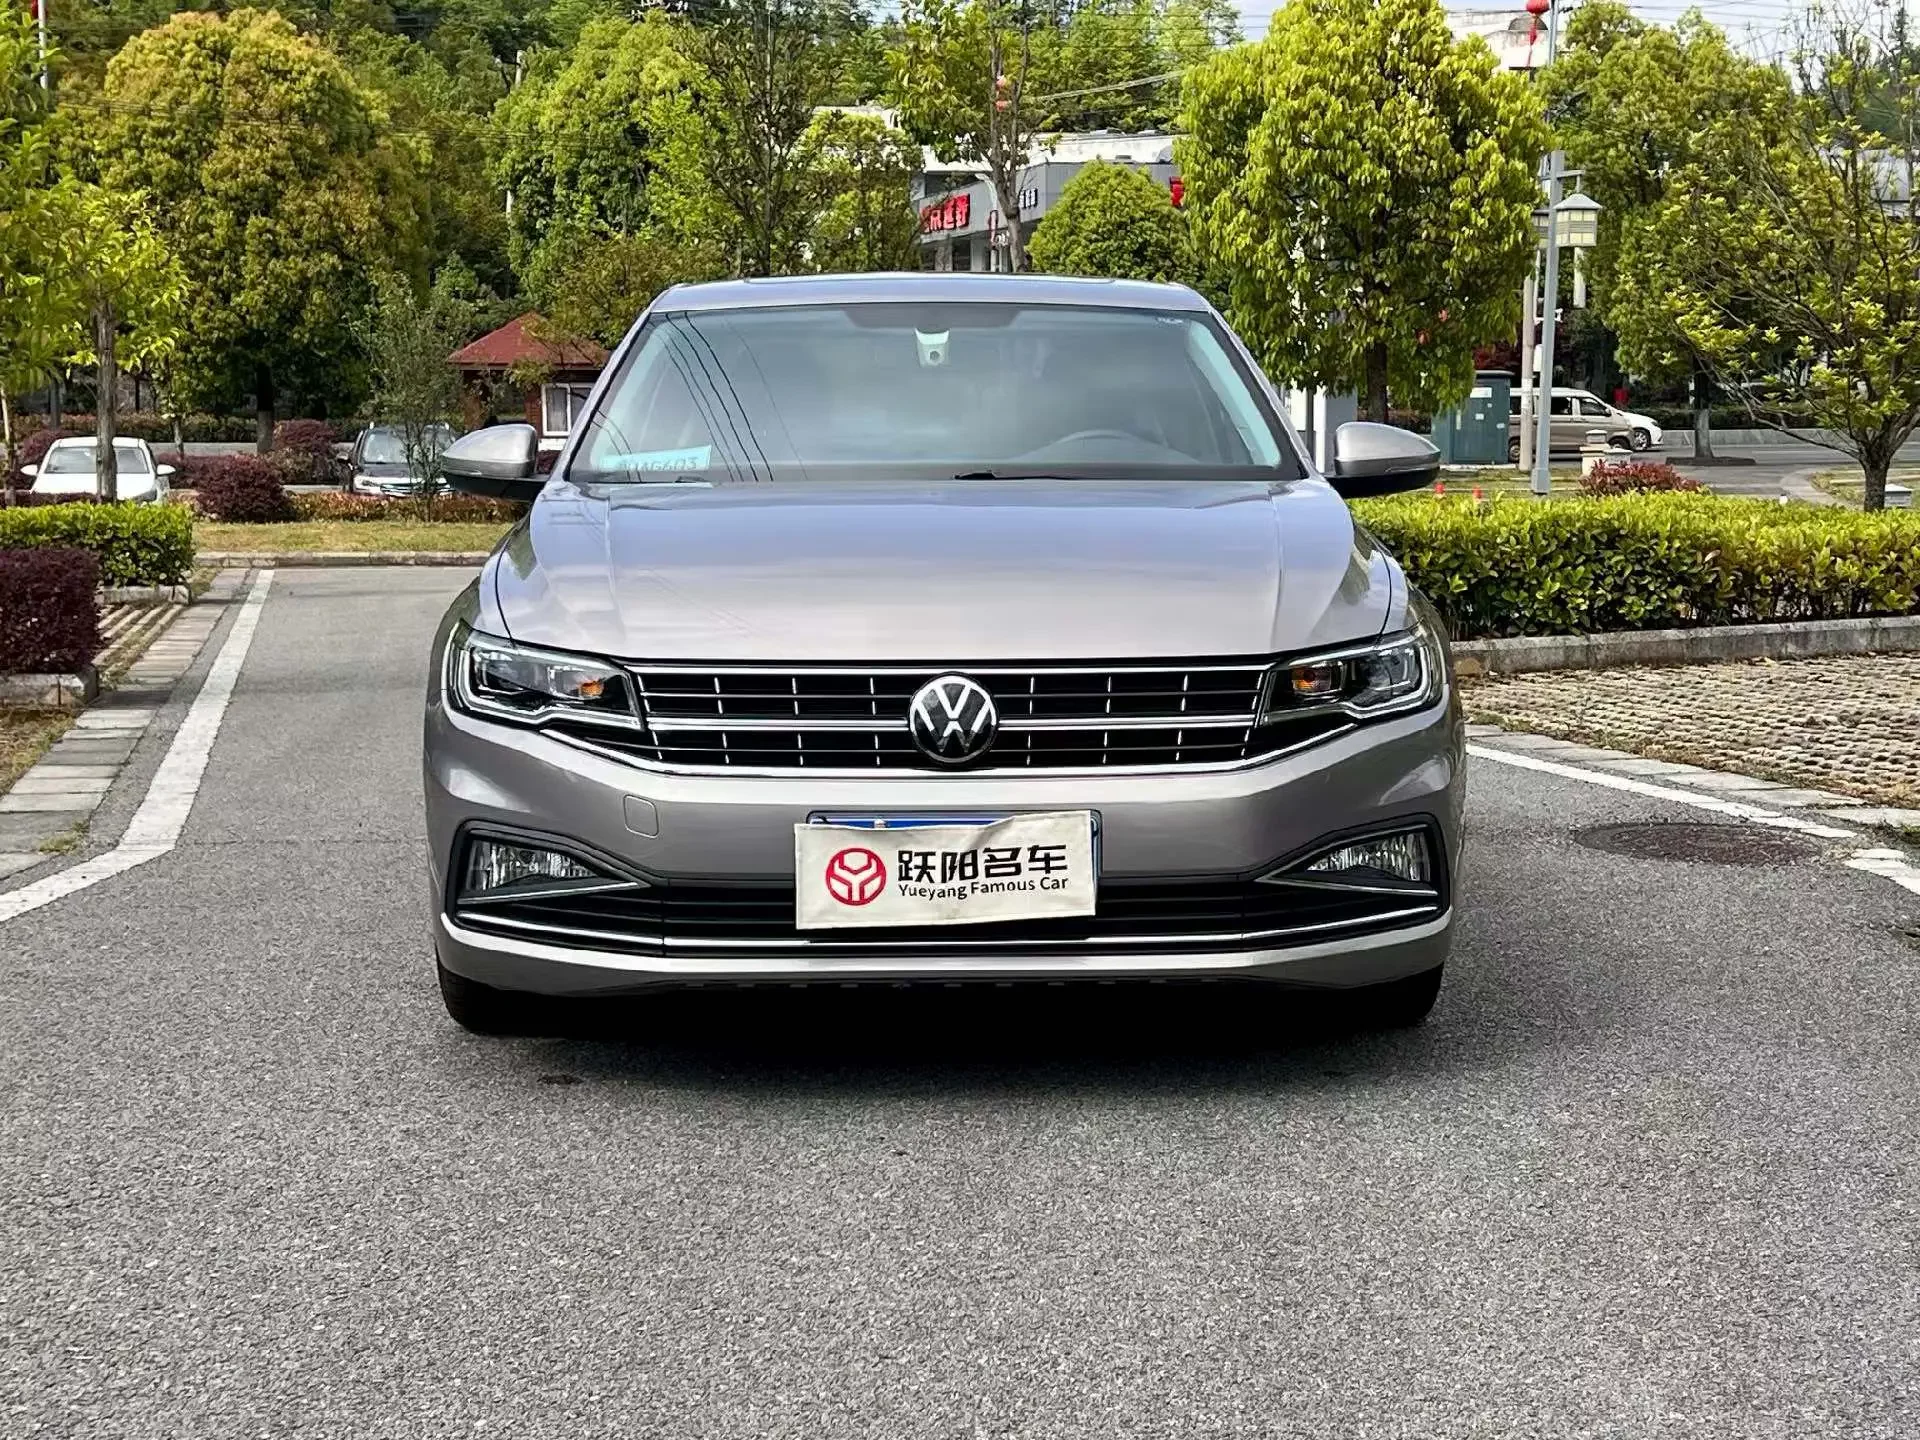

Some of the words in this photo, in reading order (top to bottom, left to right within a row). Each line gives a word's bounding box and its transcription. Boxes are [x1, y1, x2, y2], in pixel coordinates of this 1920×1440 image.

[897, 844, 1068, 884] 跃阳名车
[898, 883, 967, 900] Yueyang
[971, 879, 1036, 894] Famous
[1040, 877, 1069, 890] Car
